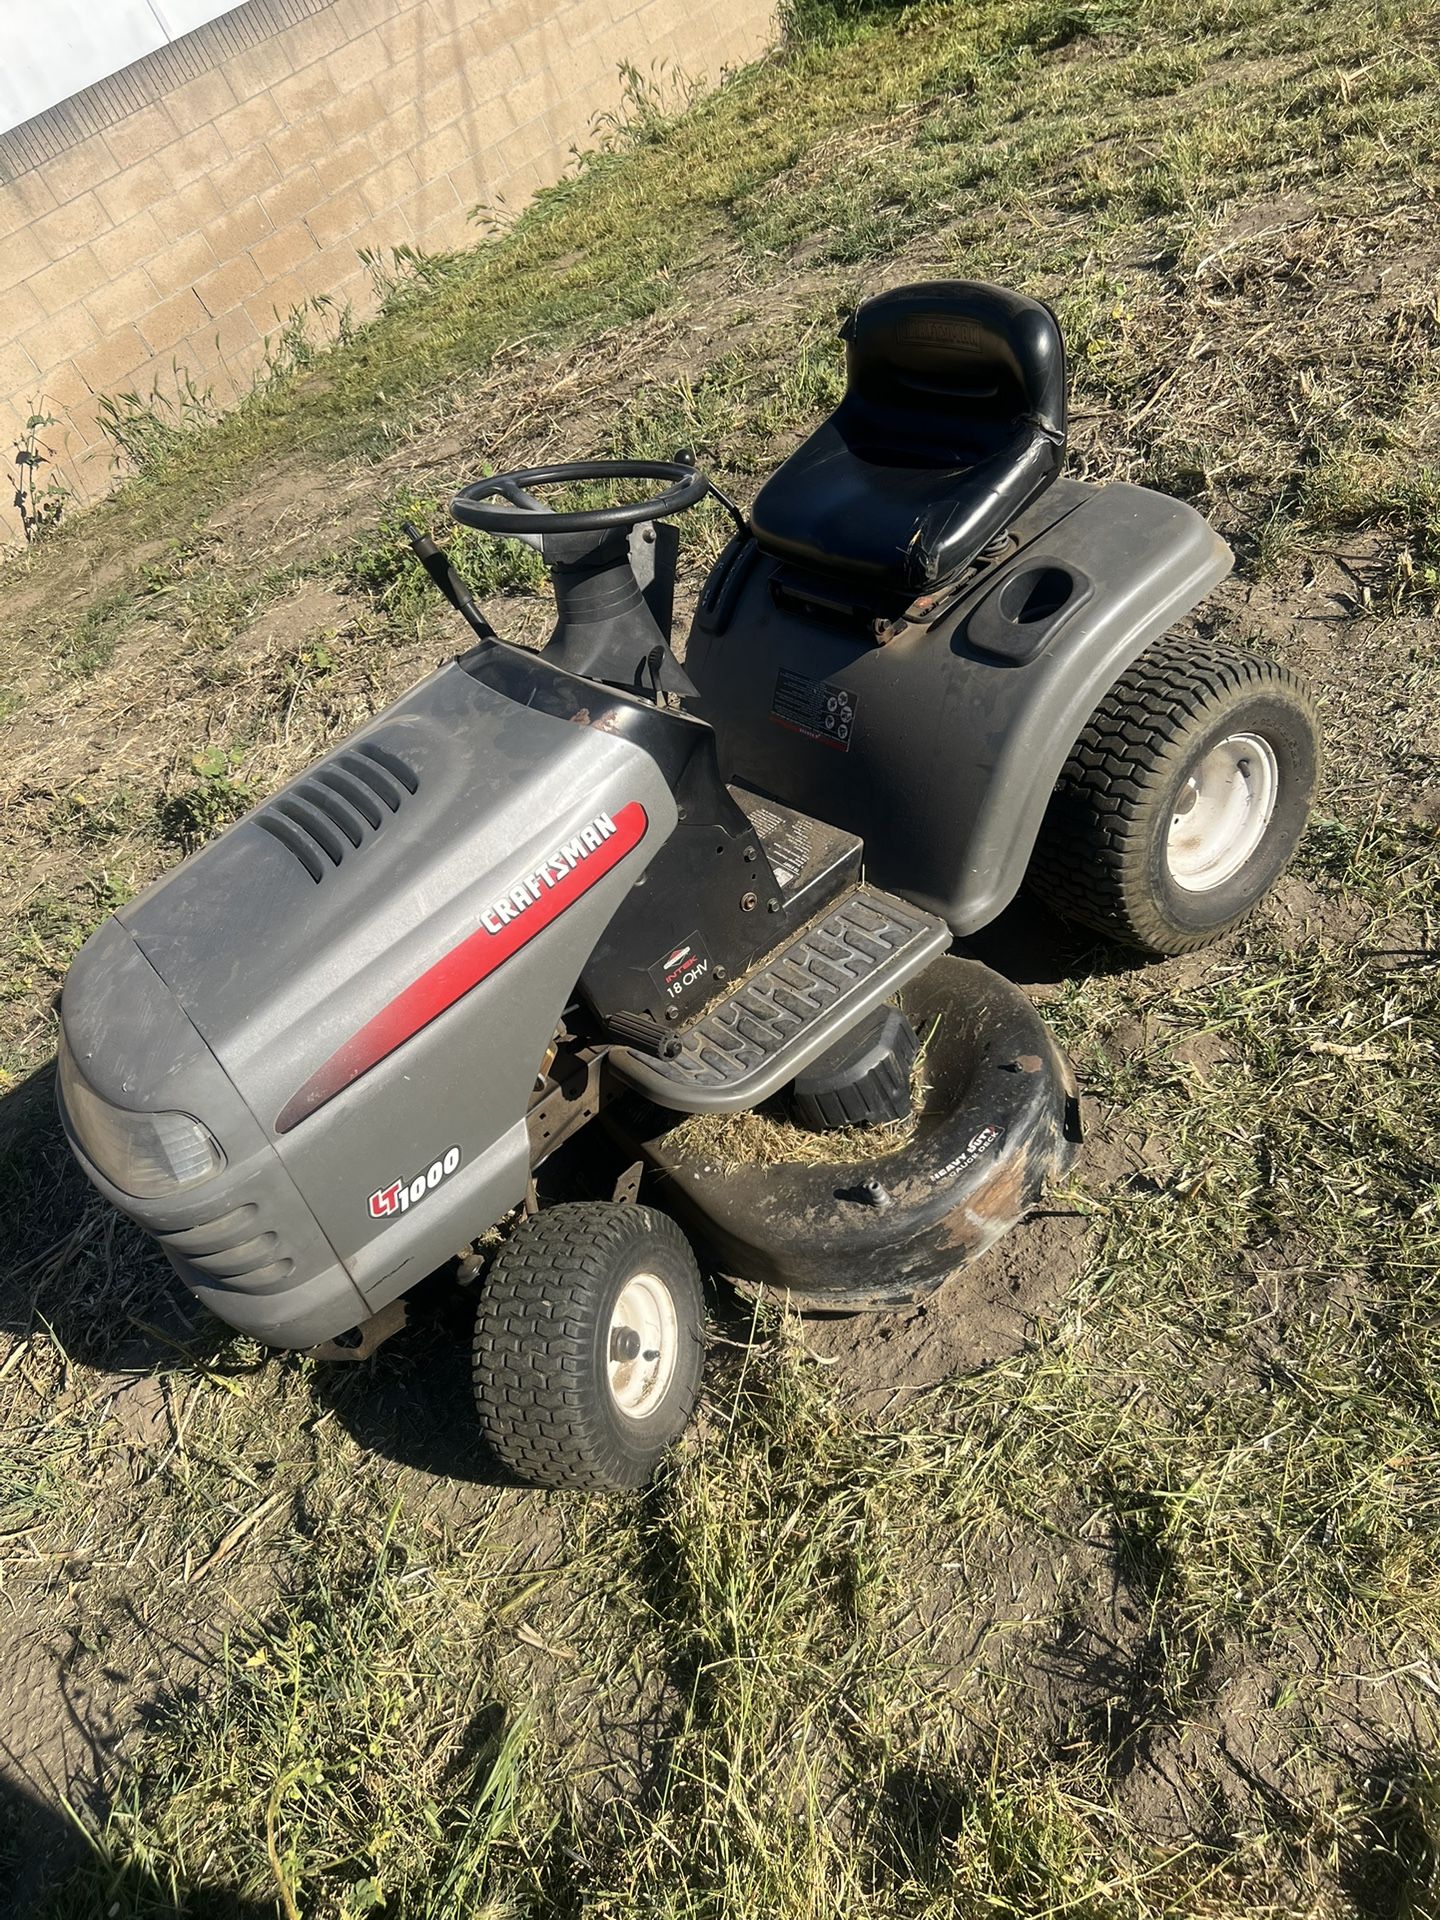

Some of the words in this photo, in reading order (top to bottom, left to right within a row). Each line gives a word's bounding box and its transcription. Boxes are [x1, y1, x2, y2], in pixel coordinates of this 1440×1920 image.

[479, 811, 617, 936] CRAFTSMAN
[665, 954, 698, 983] INTEK
[666, 981, 683, 998] 18
[682, 959, 707, 986] OHV
[929, 1152, 967, 1182] HEAVY
[967, 1127, 994, 1152] DUTY
[948, 1152, 978, 1177] GAUGE
[978, 1131, 999, 1152] DECK
